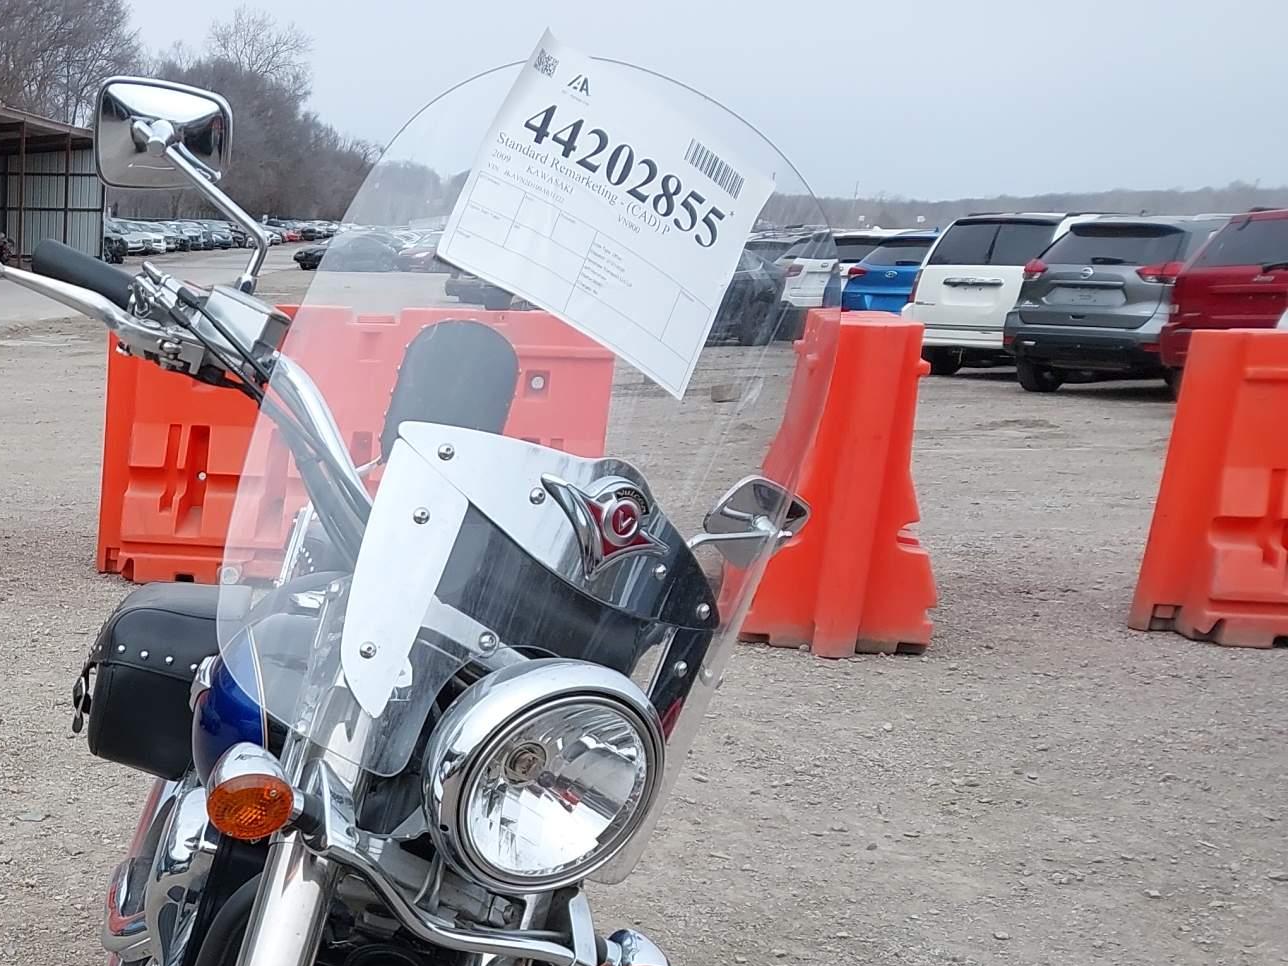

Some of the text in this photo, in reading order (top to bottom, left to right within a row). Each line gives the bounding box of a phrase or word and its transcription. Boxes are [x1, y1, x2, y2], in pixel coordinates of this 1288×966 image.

[492, 149, 512, 162] 2009
[526, 164, 574, 195] KAWASAKI
[618, 214, 641, 233] VN900
[496, 131, 549, 165] Standard
[550, 156, 618, 206] Remarketing
[626, 201, 661, 233] (CAD)
[523, 104, 726, 248] 44202855
